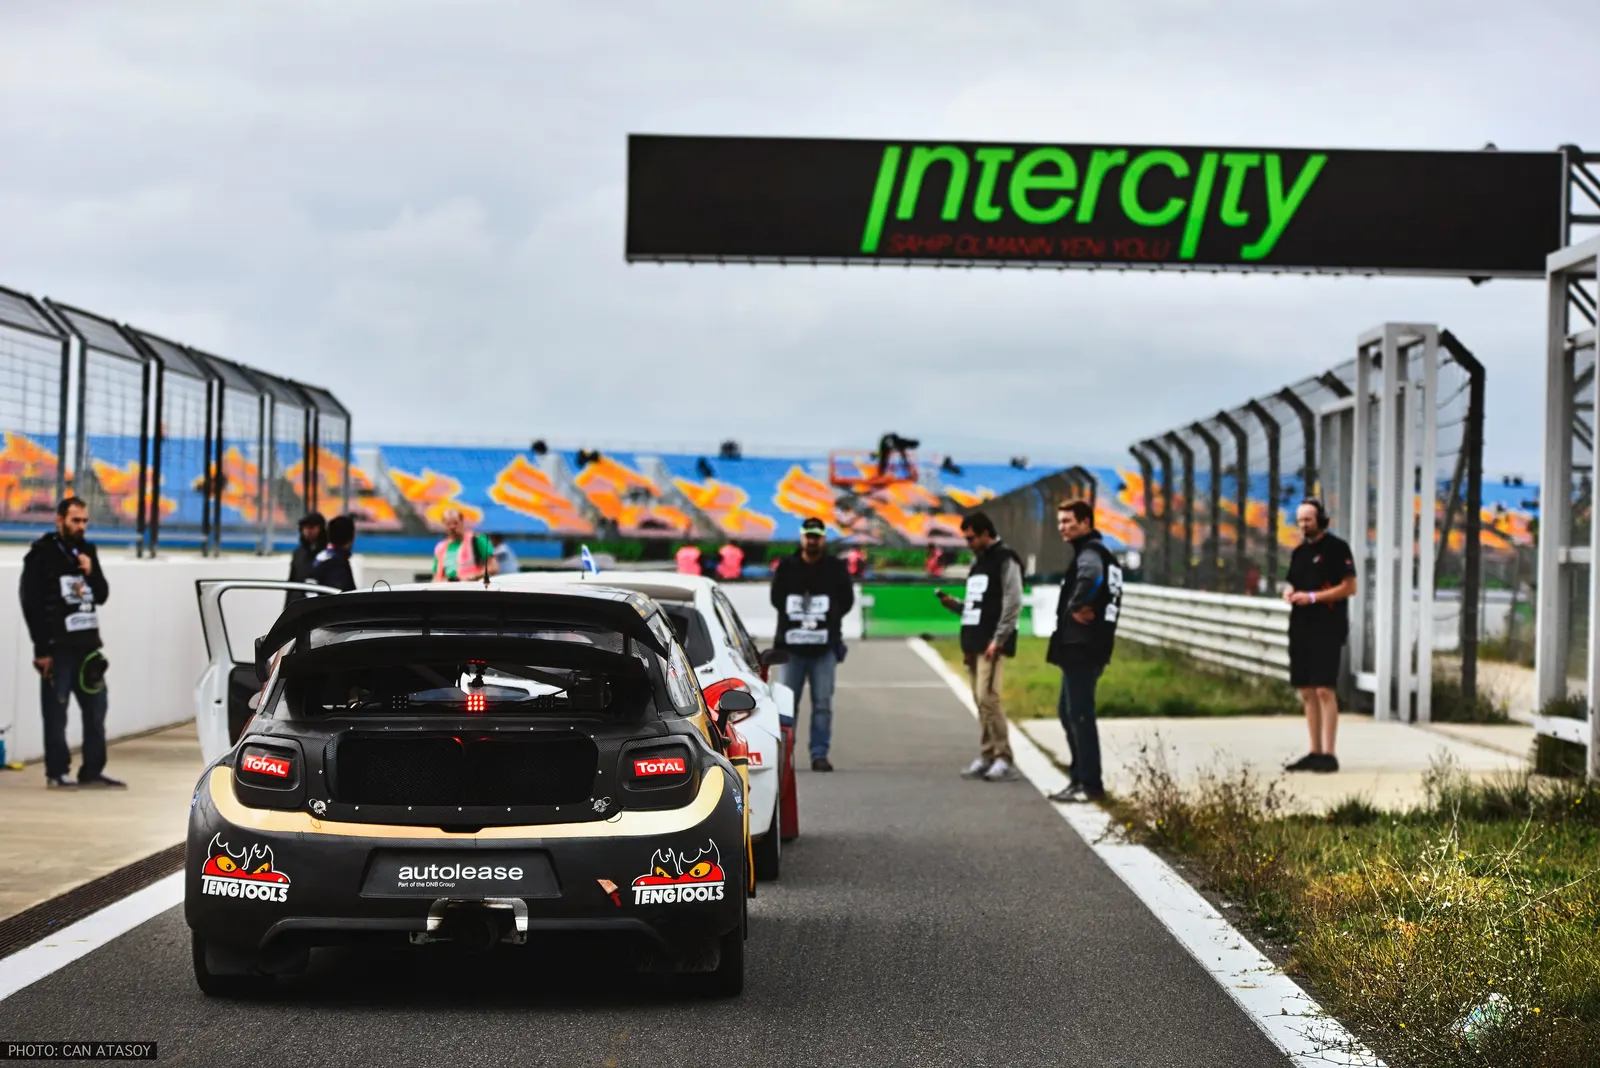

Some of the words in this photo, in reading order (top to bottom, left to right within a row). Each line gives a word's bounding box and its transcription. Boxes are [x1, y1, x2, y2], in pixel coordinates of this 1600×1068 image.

[246, 757, 286, 775] TOTAL
[636, 761, 684, 774] TOTAL
[398, 863, 524, 880] autolease
[201, 875, 290, 902] TENGTOOLS
[631, 882, 725, 905] TENGTOOLS
